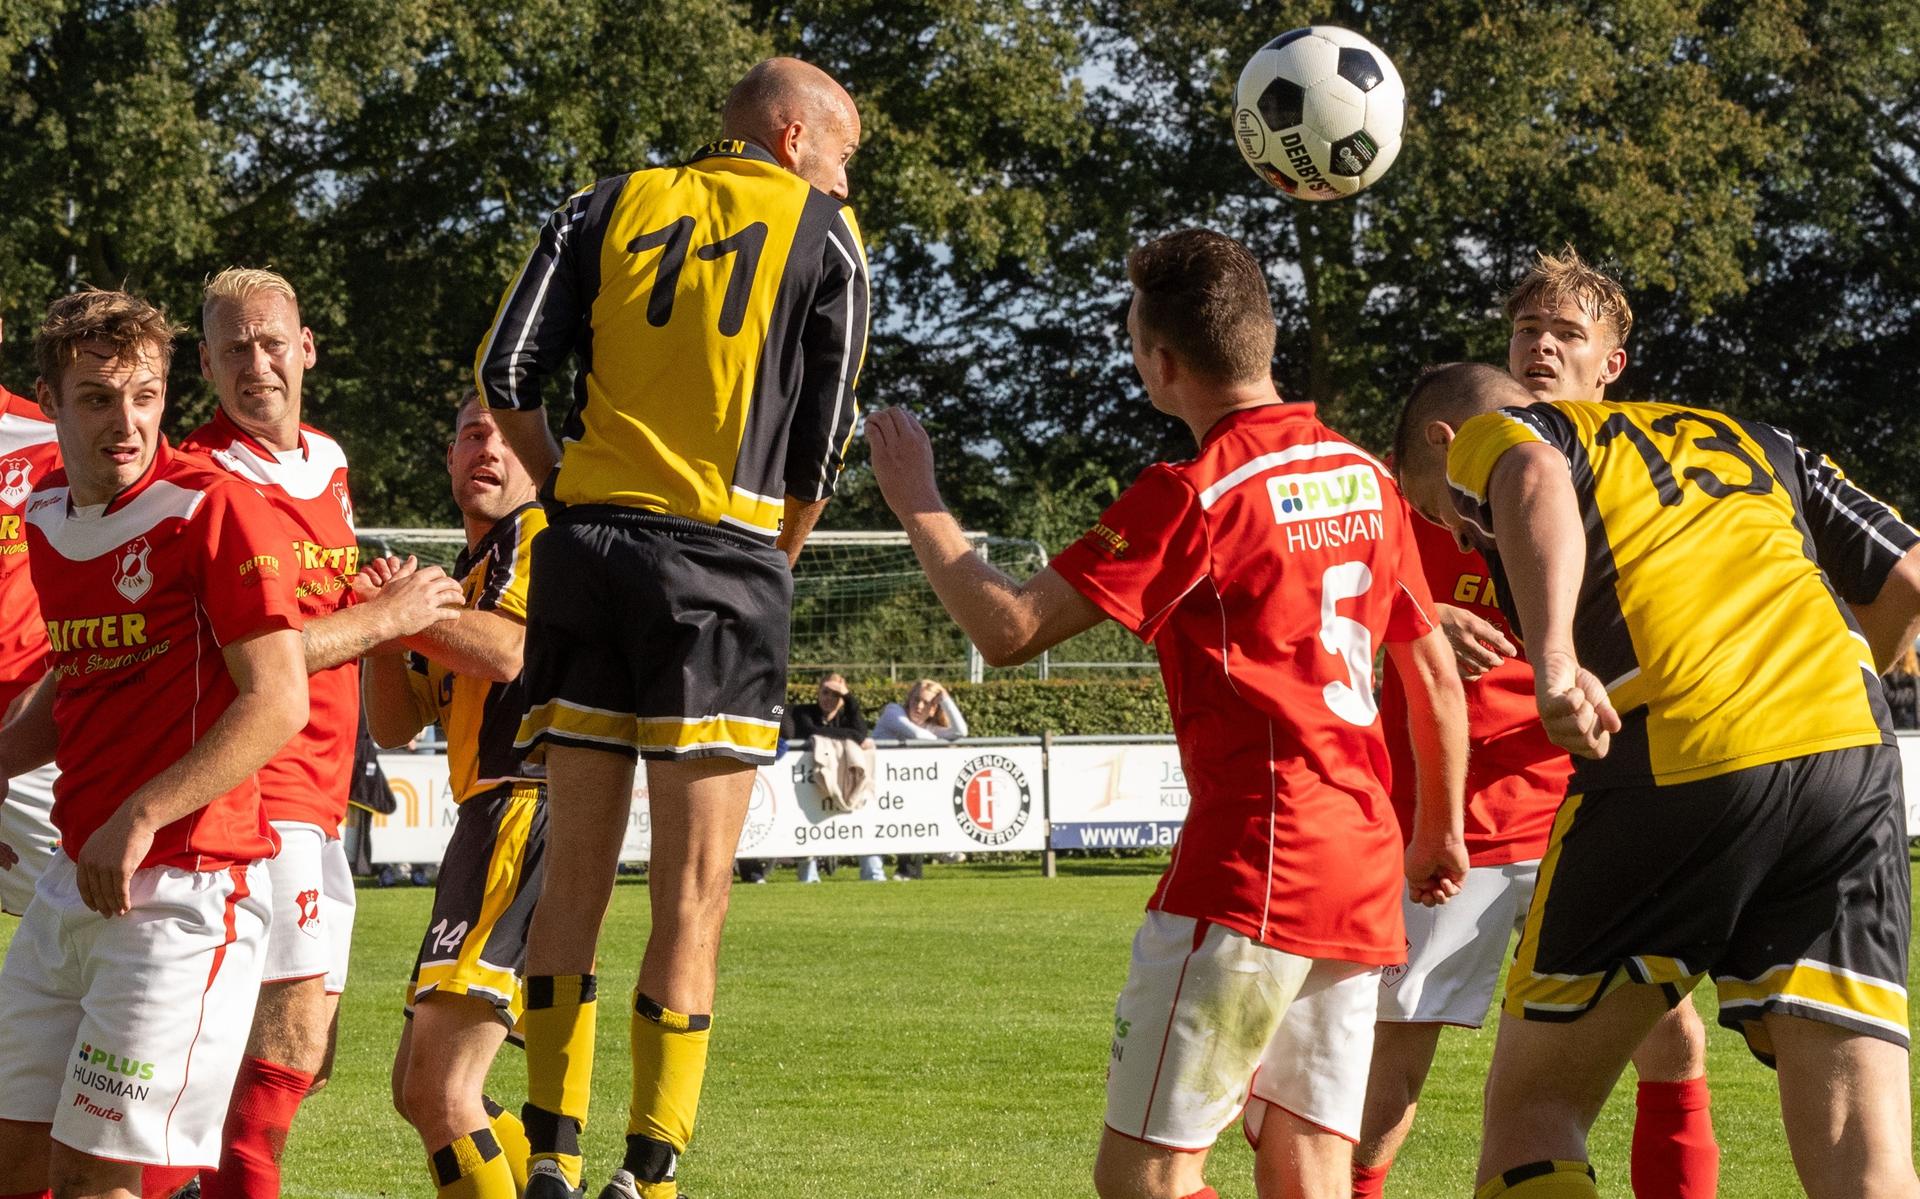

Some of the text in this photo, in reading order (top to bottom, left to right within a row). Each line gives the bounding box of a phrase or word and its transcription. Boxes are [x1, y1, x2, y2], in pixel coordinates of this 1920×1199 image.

[707, 139, 746, 154] SCN
[626, 215, 769, 338] 11
[1595, 410, 1774, 508] 13
[1303, 473, 1377, 511] PLUS
[47, 612, 148, 653] RITTER
[1319, 561, 1377, 726] 5
[886, 762, 938, 782] hand
[954, 754, 1029, 789] FEYENOORD
[878, 791, 904, 810] de
[794, 821, 863, 845] goden
[875, 823, 939, 839] zonen
[956, 809, 1031, 846] ROTTERDAM
[432, 918, 468, 954] 14
[73, 1063, 150, 1101] HUISMAN
[91, 1048, 155, 1081] PLUS
